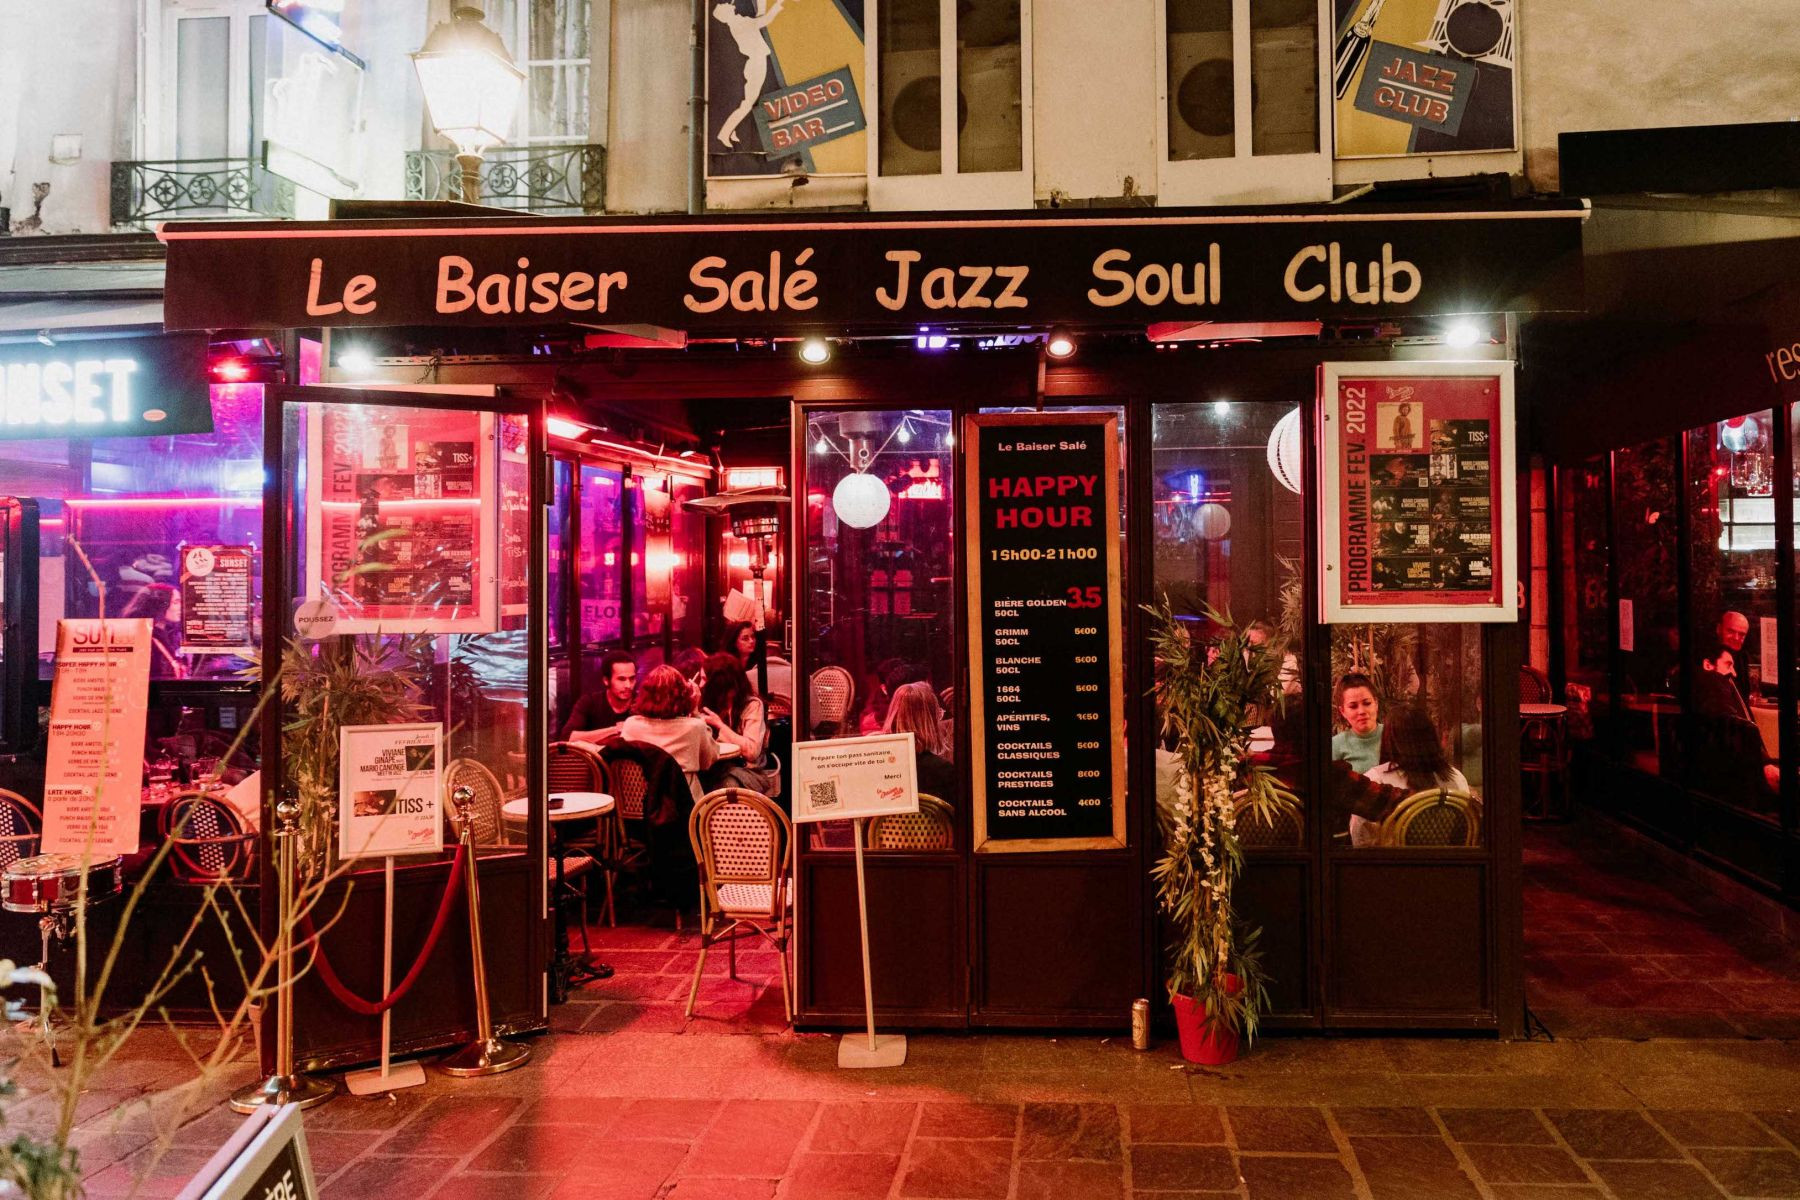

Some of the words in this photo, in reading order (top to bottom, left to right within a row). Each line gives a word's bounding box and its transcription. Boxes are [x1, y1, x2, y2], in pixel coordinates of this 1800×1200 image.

[1382, 57, 1457, 92] JAZZ
[763, 78, 844, 120] VIDEO
[1373, 86, 1450, 124] CLUB
[770, 117, 826, 149] BAR
[306, 257, 377, 316] Le
[435, 255, 628, 315] Baiser
[683, 247, 819, 313] Salé
[875, 250, 1030, 311] Jazz
[1087, 242, 1221, 307] Soul
[1284, 242, 1422, 305] Club
[0, 358, 138, 425] NSET
[1345, 386, 1367, 435] 2022
[998, 443, 1013, 452] Le
[1016, 442, 1056, 451] Baiser
[1059, 440, 1088, 450] Salé
[989, 475, 1098, 498] HAPPY
[996, 506, 1092, 529] HOUR
[1347, 479, 1368, 593] PROGRAMME
[1026, 599, 1067, 607] GOLDEN
[994, 609, 1020, 617] 50CL
[298, 615, 334, 623] POUSSEZ
[994, 628, 1029, 636] GRIMM
[995, 638, 1021, 646] 50CL
[995, 656, 1042, 665] BLANCHE
[995, 666, 1021, 674] 50CL
[996, 685, 1021, 693] 1664
[996, 695, 1022, 703] 50CL
[996, 723, 1021, 731] VINS
[997, 742, 1053, 750] COCKTAILS
[381, 748, 405, 757] VIVIANE
[848, 752, 862, 760] pass
[997, 751, 1061, 760] CLASSIQUES
[360, 764, 379, 773] MARIO
[997, 770, 1053, 779] COCKTAILS
[997, 780, 1054, 788] PRESTIGES
[397, 797, 423, 815] TISS
[426, 800, 434, 809] +
[998, 799, 1054, 808] COCKTAILS
[998, 809, 1026, 817] SANS
[1028, 808, 1068, 817] ALCOOL
